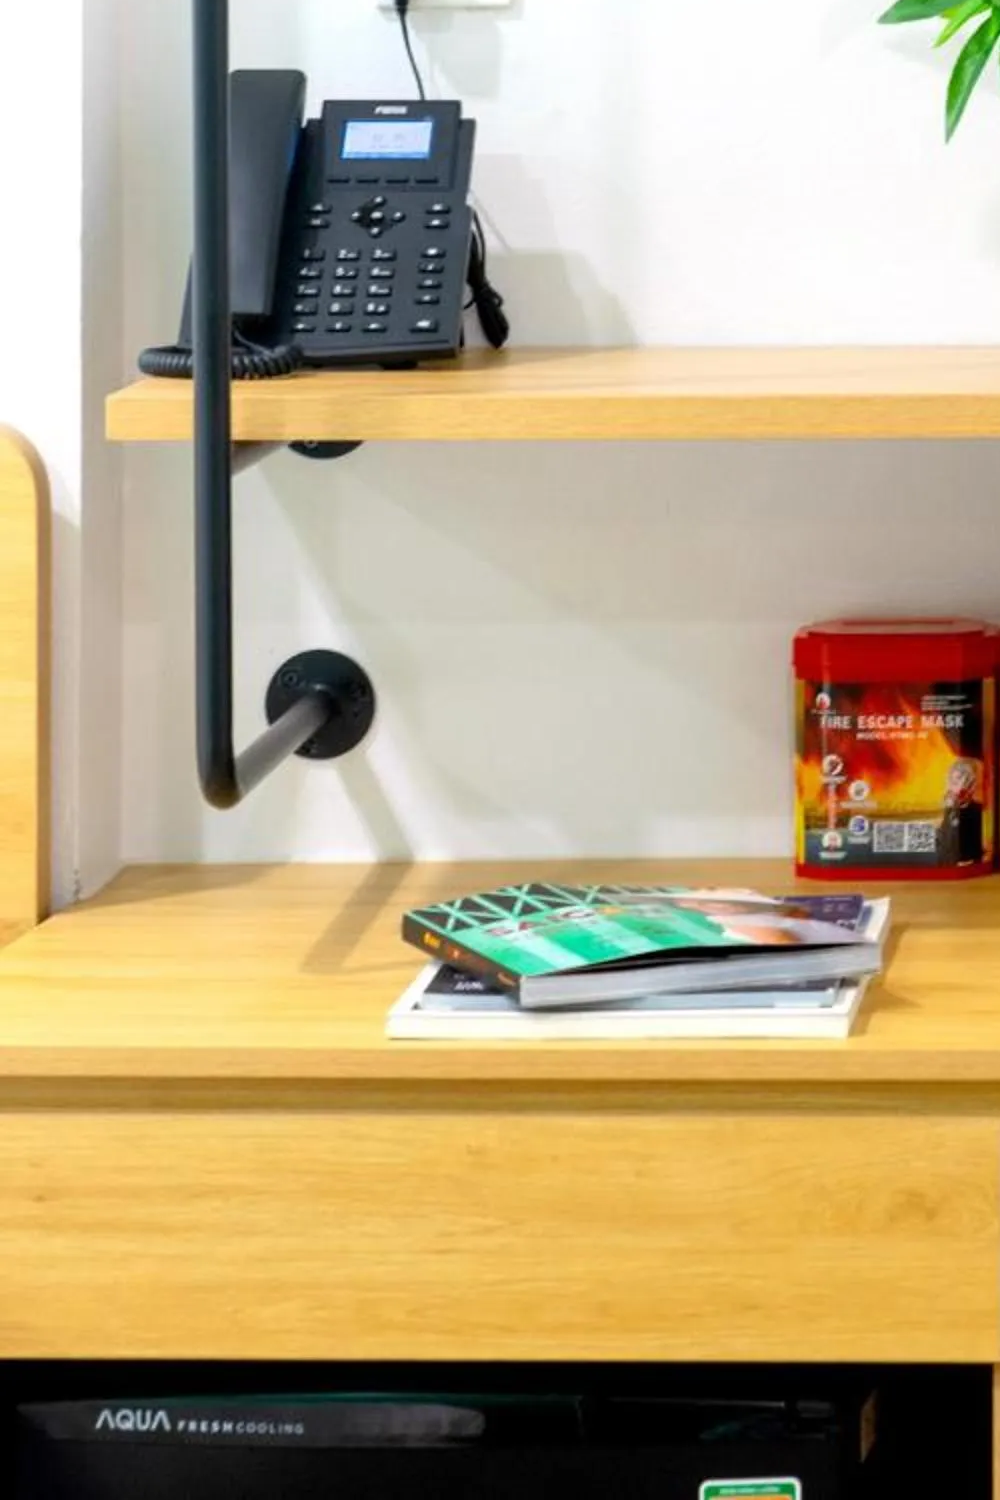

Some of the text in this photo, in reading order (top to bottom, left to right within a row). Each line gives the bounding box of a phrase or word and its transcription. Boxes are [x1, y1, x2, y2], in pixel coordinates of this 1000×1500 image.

[819, 713, 965, 730] FIRE ESCAPE MASK
[95, 1408, 172, 1432] AQUA
